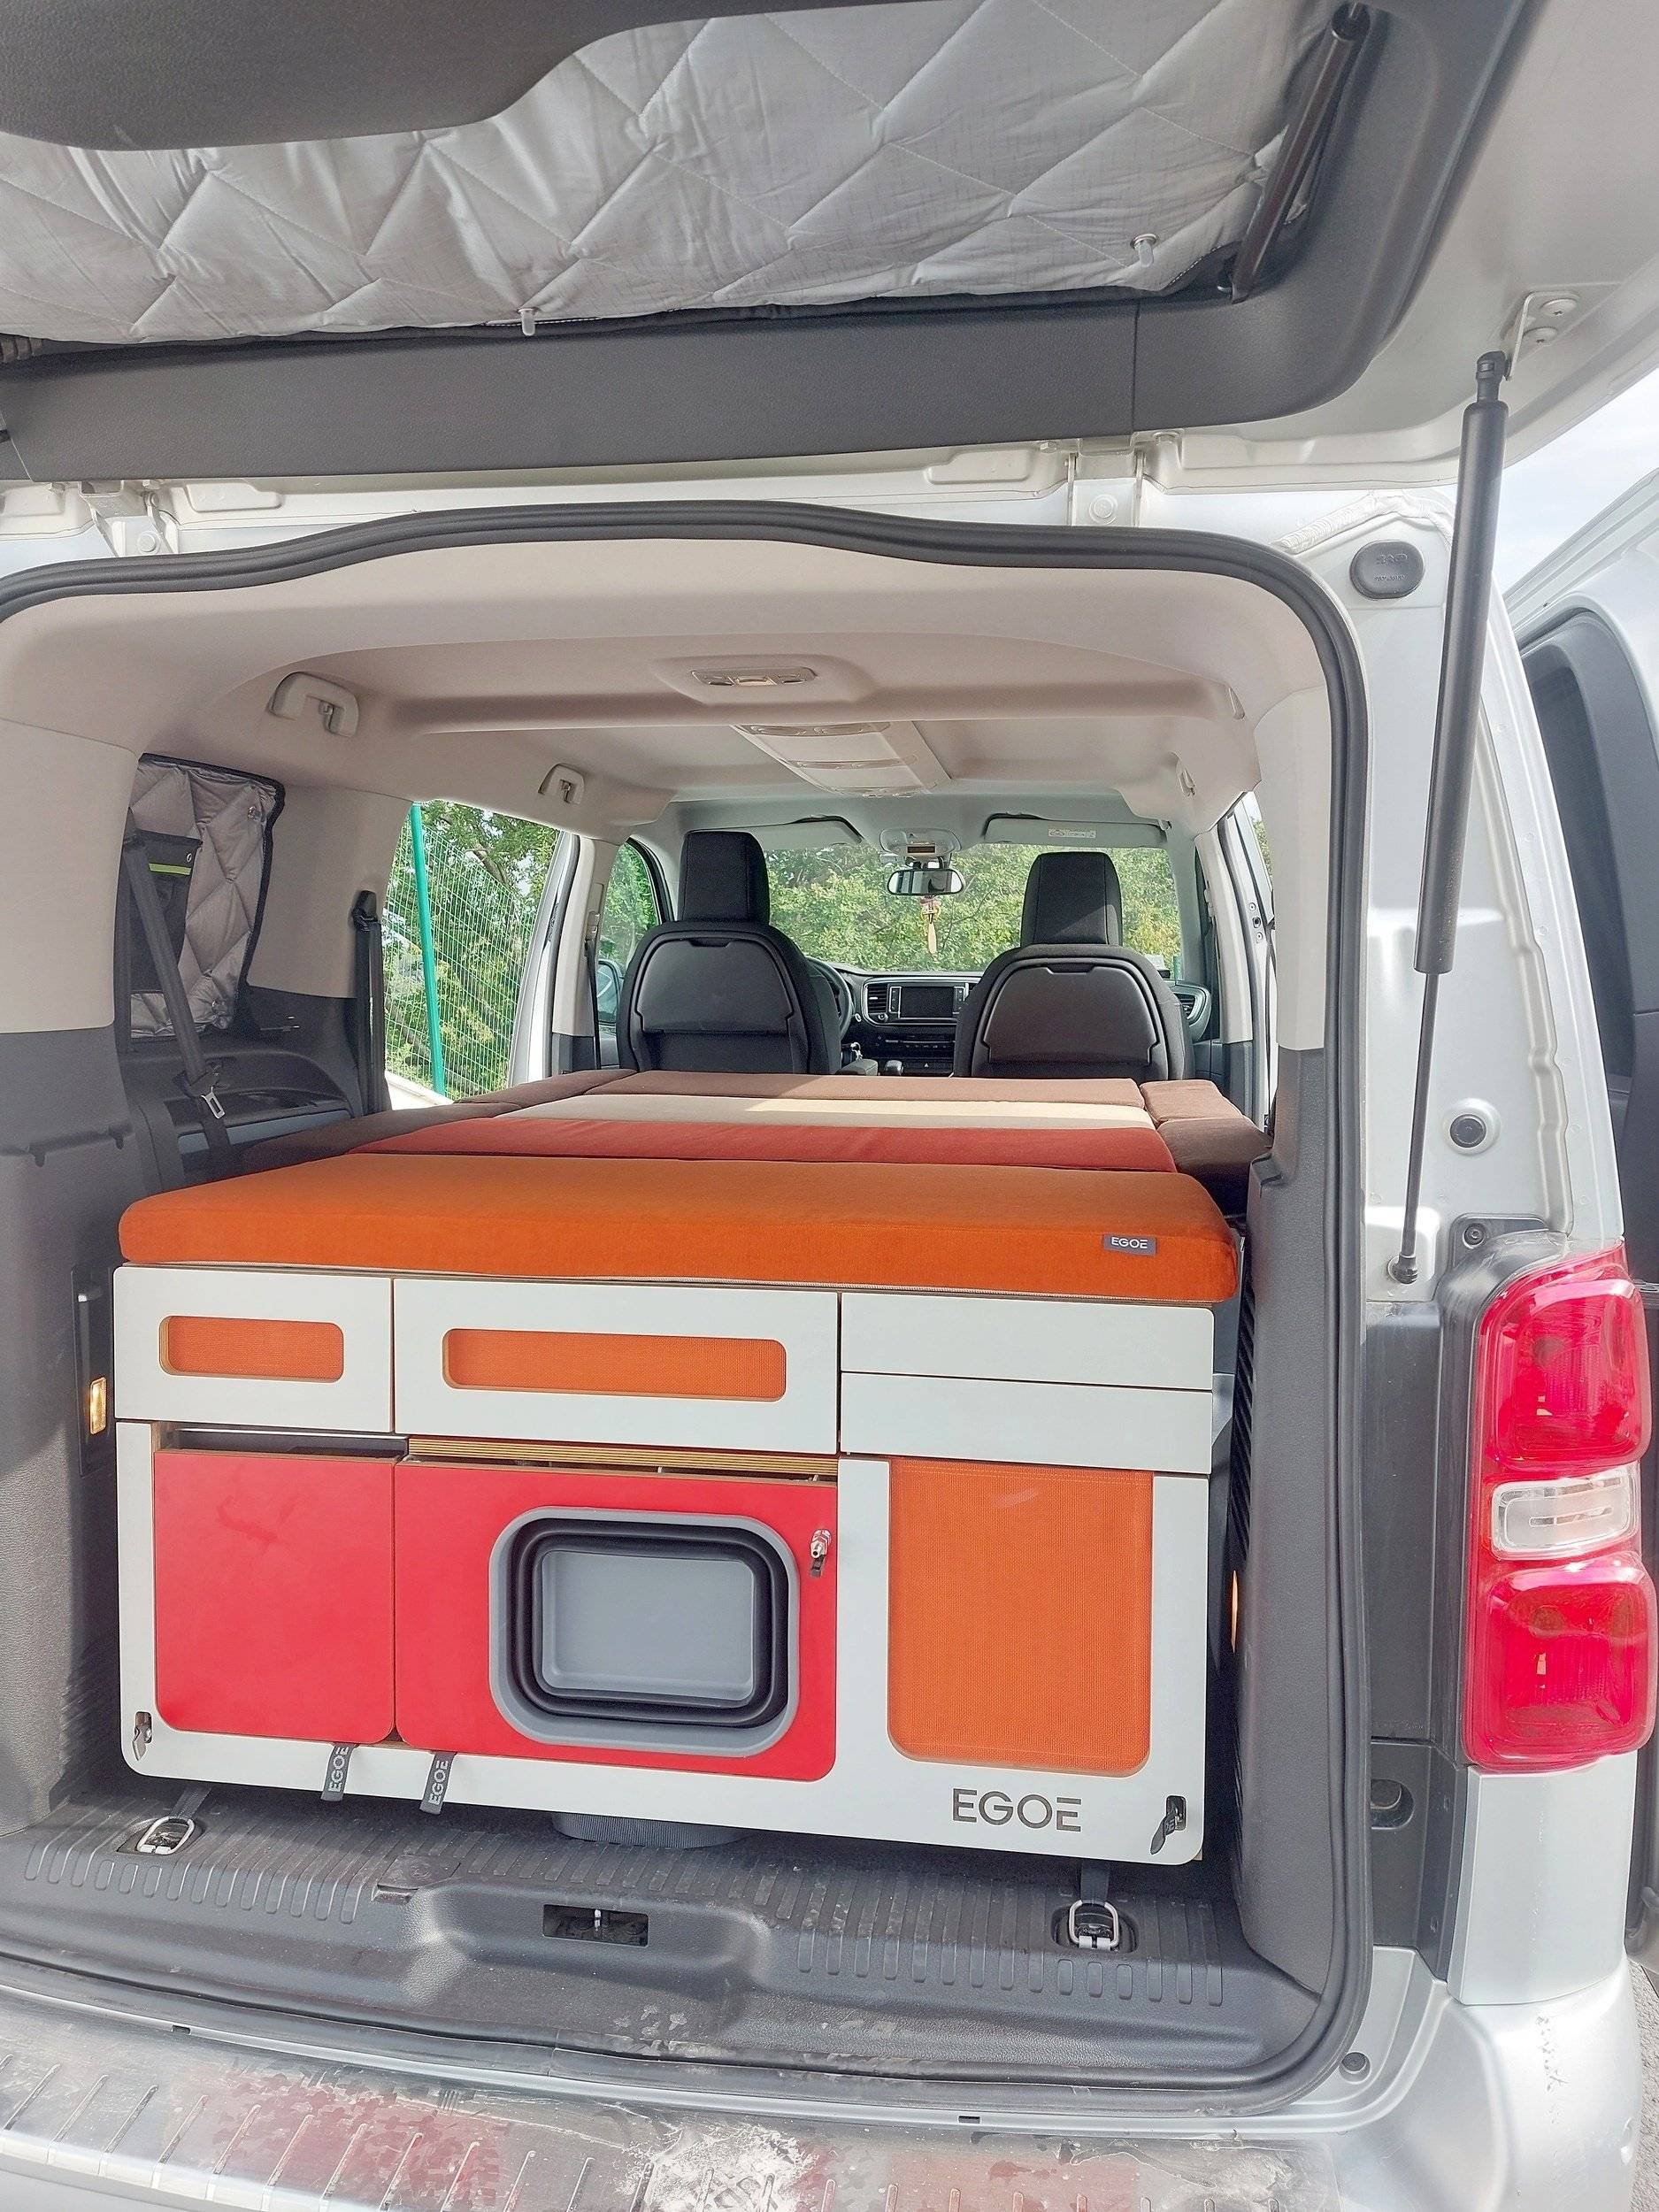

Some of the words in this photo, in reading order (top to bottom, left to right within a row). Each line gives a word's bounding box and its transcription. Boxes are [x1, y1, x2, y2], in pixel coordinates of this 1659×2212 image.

[1111, 1237, 1148, 1248] EGOE
[328, 1747, 349, 1793] EGOE
[427, 1760, 449, 1805] EGOE
[953, 1788, 1081, 1832] EGOE
